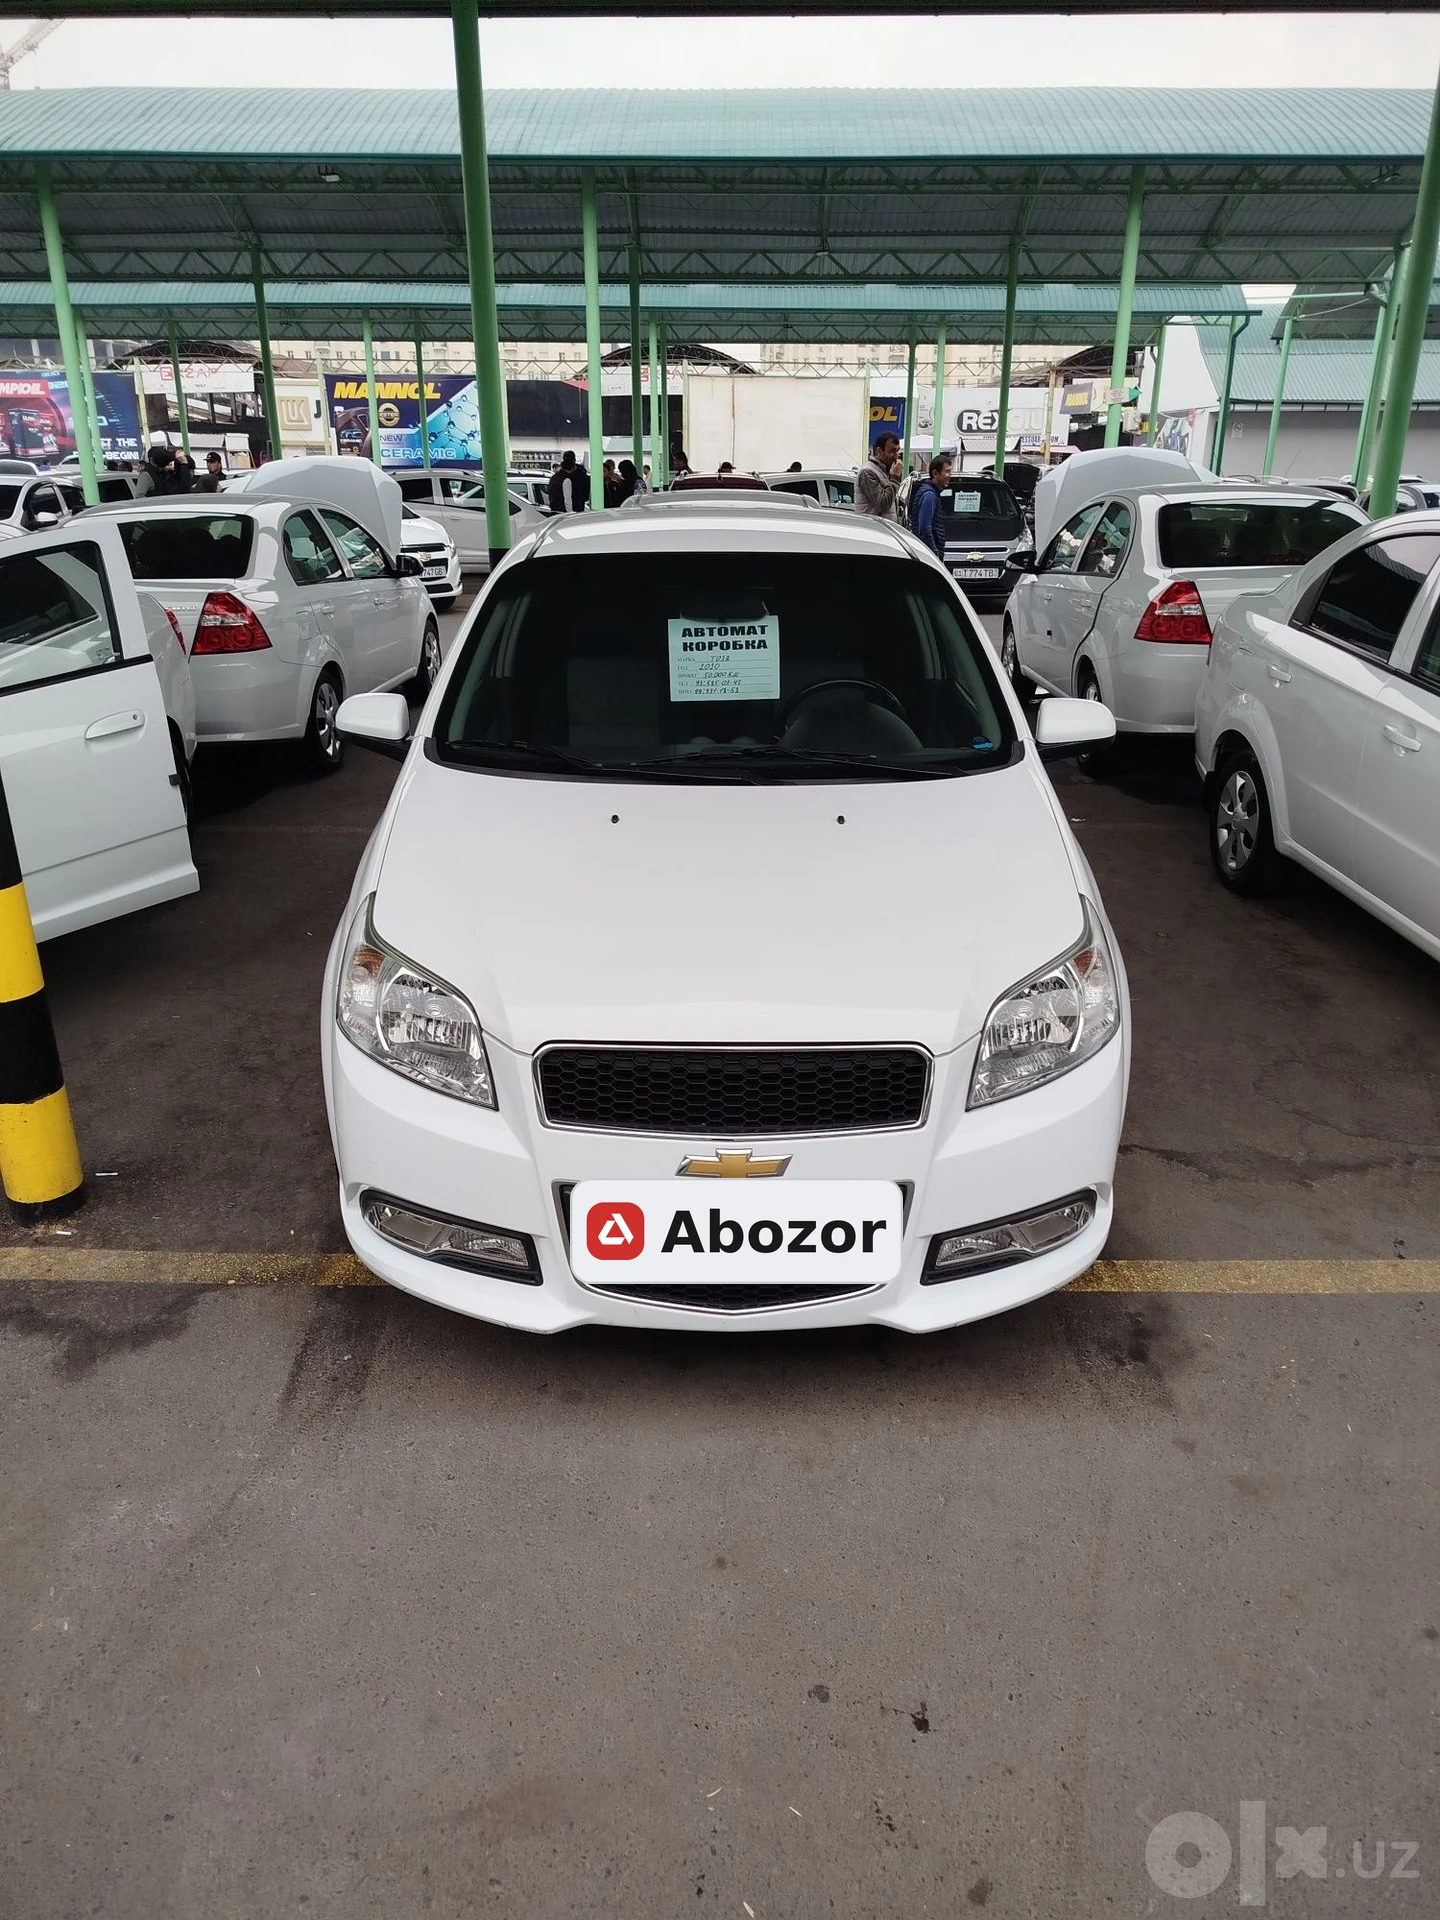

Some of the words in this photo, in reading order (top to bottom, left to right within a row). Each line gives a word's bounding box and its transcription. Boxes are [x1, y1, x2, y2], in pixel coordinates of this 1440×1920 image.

[334, 382, 441, 399] MANNOL
[116, 438, 138, 447] THE
[380, 434, 403, 442] NEW
[381, 448, 456, 459] CERAMIC
[681, 625, 768, 638] АВТОМАТ
[682, 639, 768, 652] КОРОБКА
